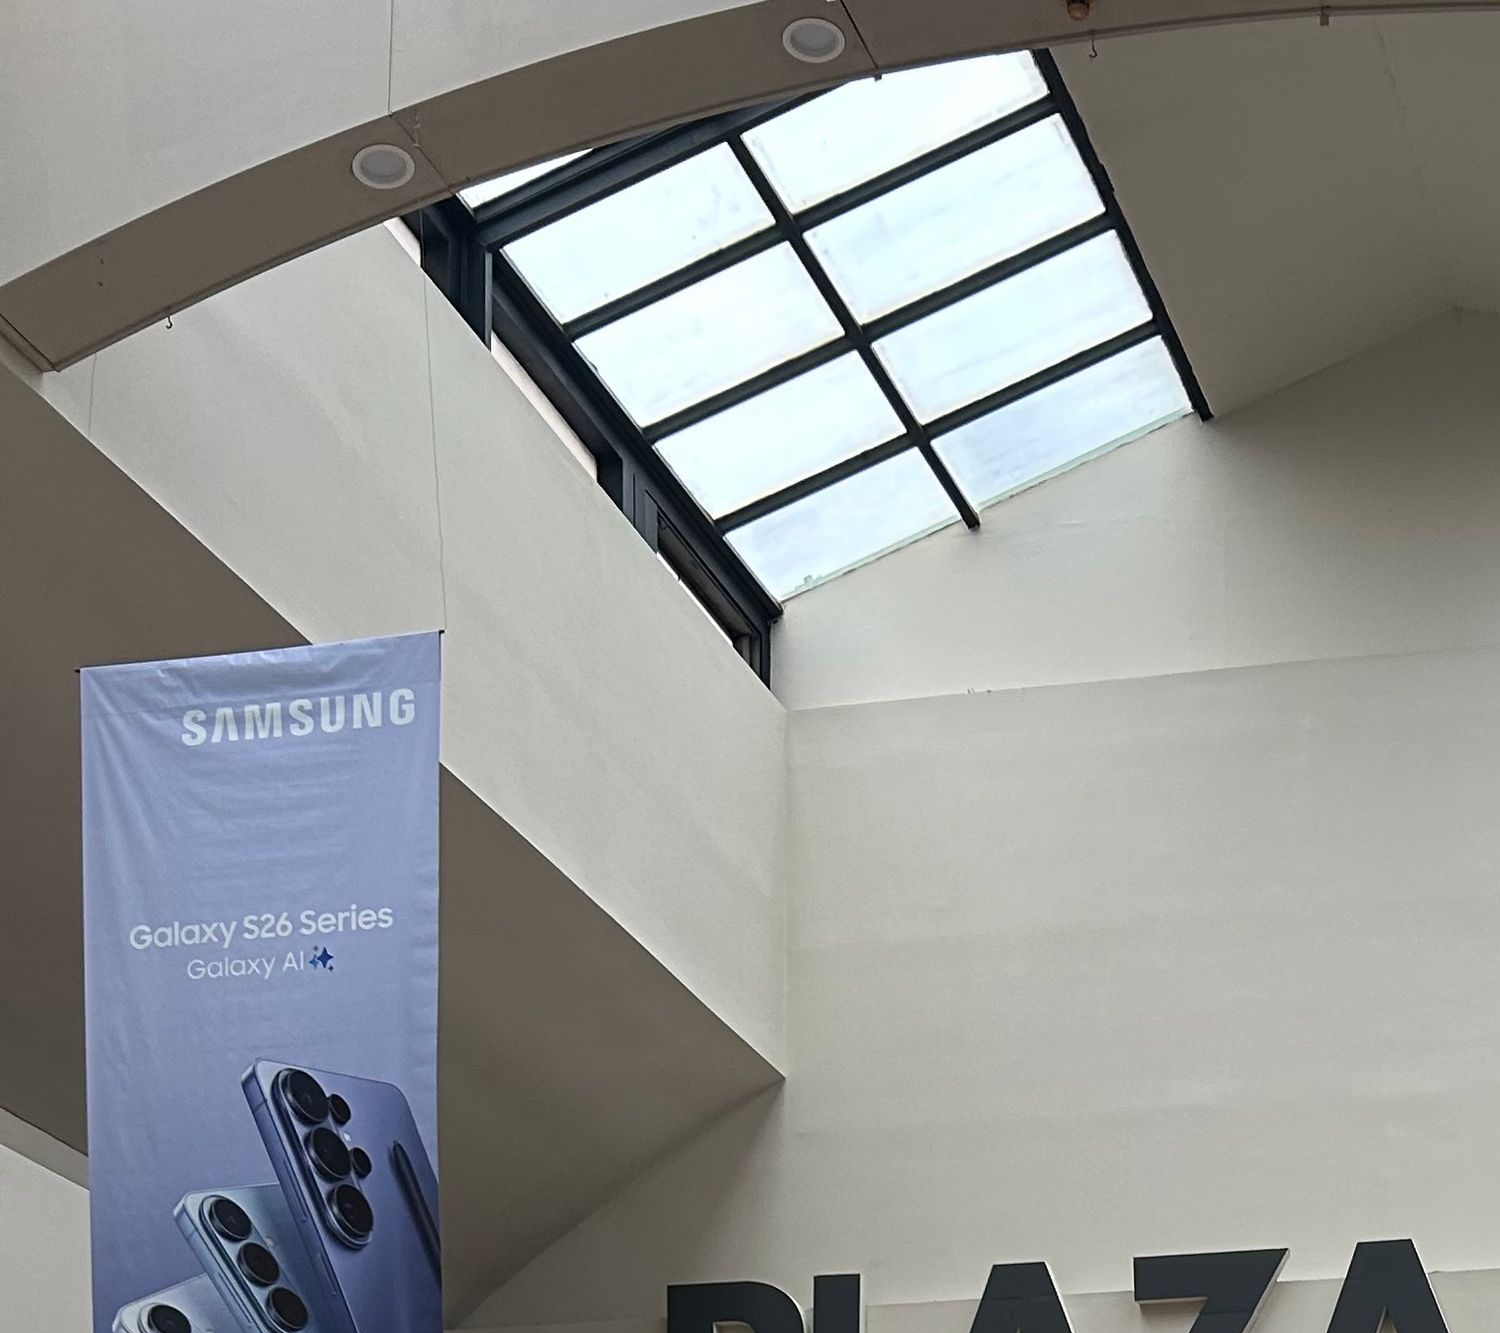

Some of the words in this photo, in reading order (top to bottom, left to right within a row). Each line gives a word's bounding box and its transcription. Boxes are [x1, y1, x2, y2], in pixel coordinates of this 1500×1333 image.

[181, 688, 416, 747] SAMSUNG
[129, 918, 238, 951] Galaxy
[243, 911, 294, 941] S26
[299, 903, 394, 935] Series
[186, 953, 276, 981] Galaxy
[282, 951, 305, 972] AI
